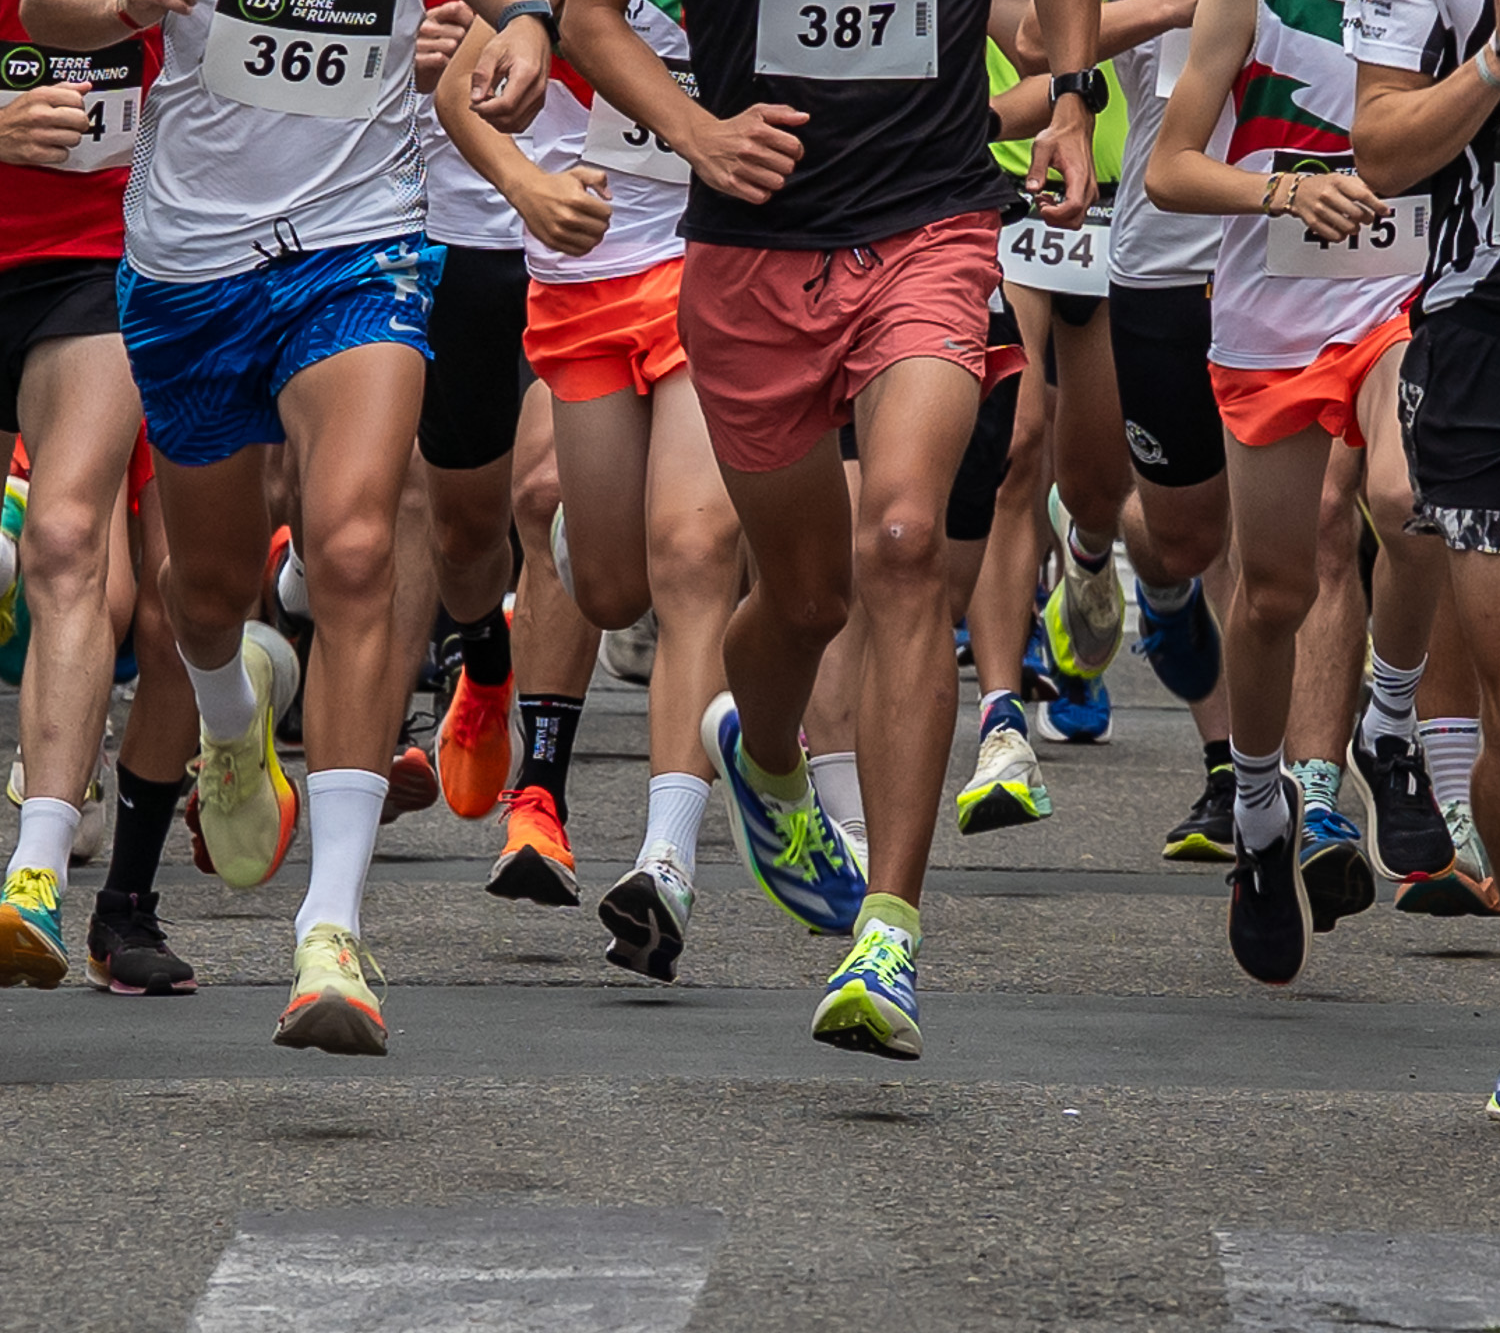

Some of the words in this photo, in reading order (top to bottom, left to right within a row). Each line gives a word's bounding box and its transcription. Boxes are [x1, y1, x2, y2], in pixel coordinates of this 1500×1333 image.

[305, 10, 378, 25] RUNNING
[797, 3, 896, 49] 387
[8, 60, 40, 76] TDR
[49, 57, 92, 69] TERRE
[243, 35, 348, 86] 366
[67, 67, 129, 83] RUNNING
[1011, 228, 1094, 268] 454
